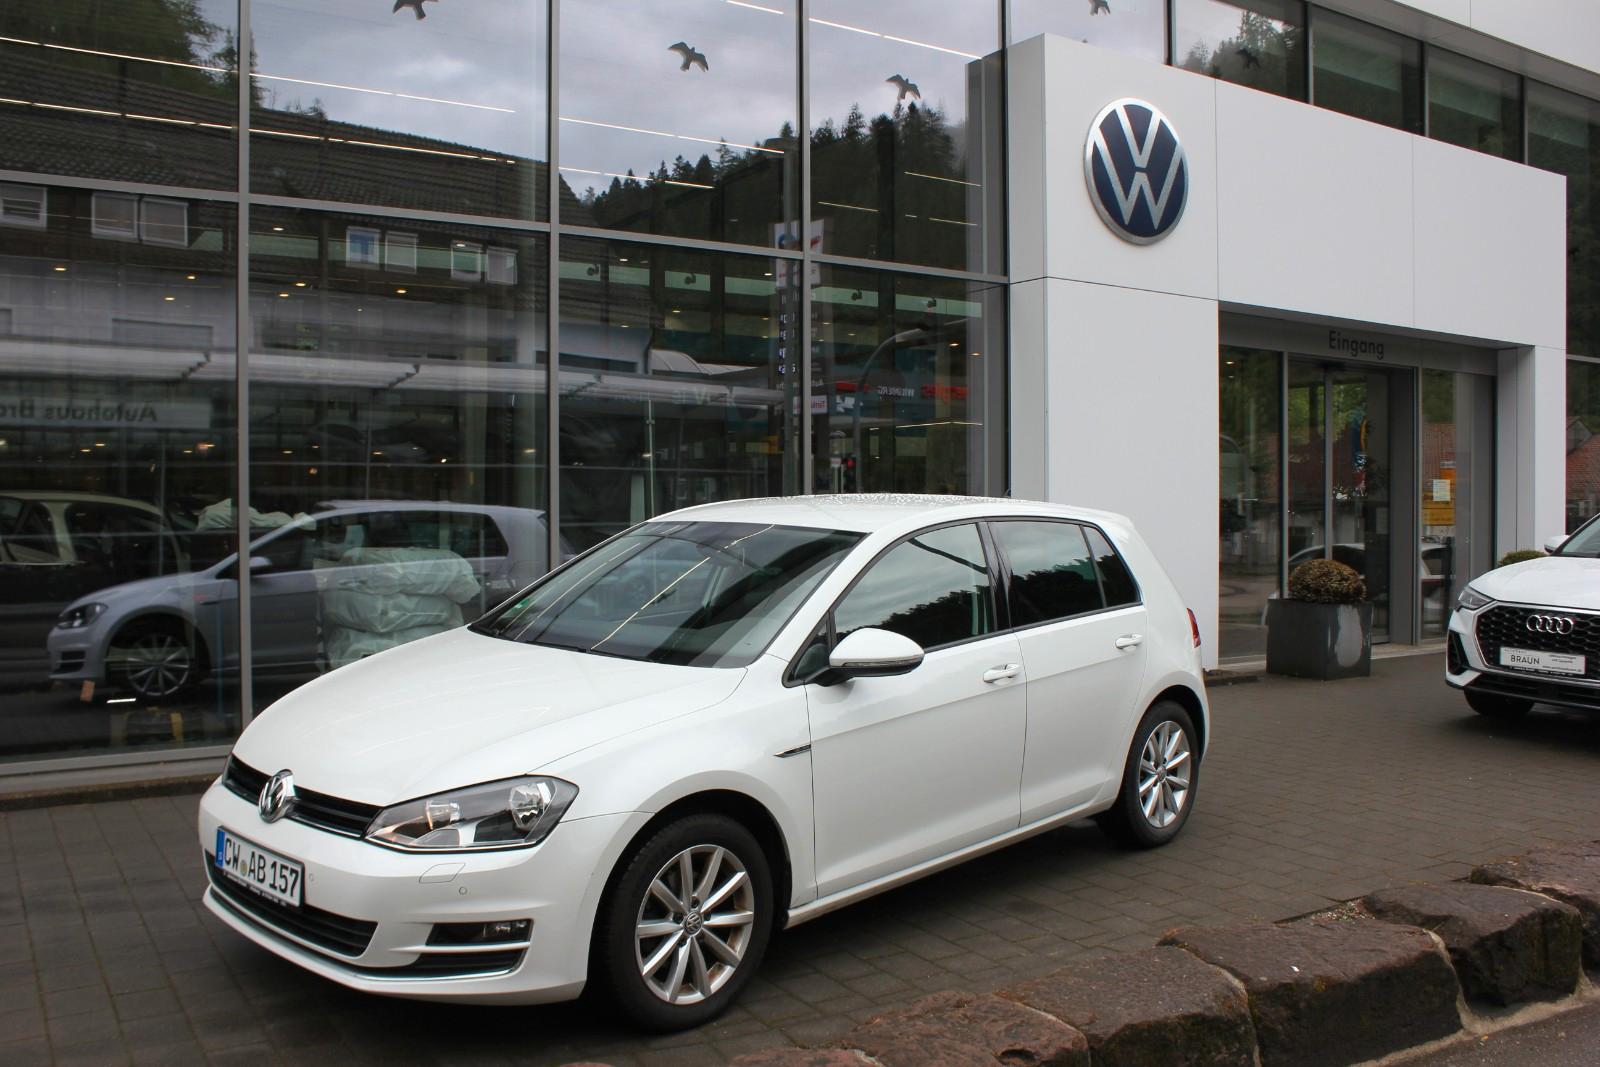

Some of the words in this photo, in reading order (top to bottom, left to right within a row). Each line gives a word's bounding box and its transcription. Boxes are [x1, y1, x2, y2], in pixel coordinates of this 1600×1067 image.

[1086, 99, 1187, 240] VW
[1329, 330, 1384, 360] Eingang
[1510, 654, 1540, 665] BRAUN
[224, 838, 241, 871] CW
[248, 851, 267, 883] AB
[269, 861, 299, 898] 157
